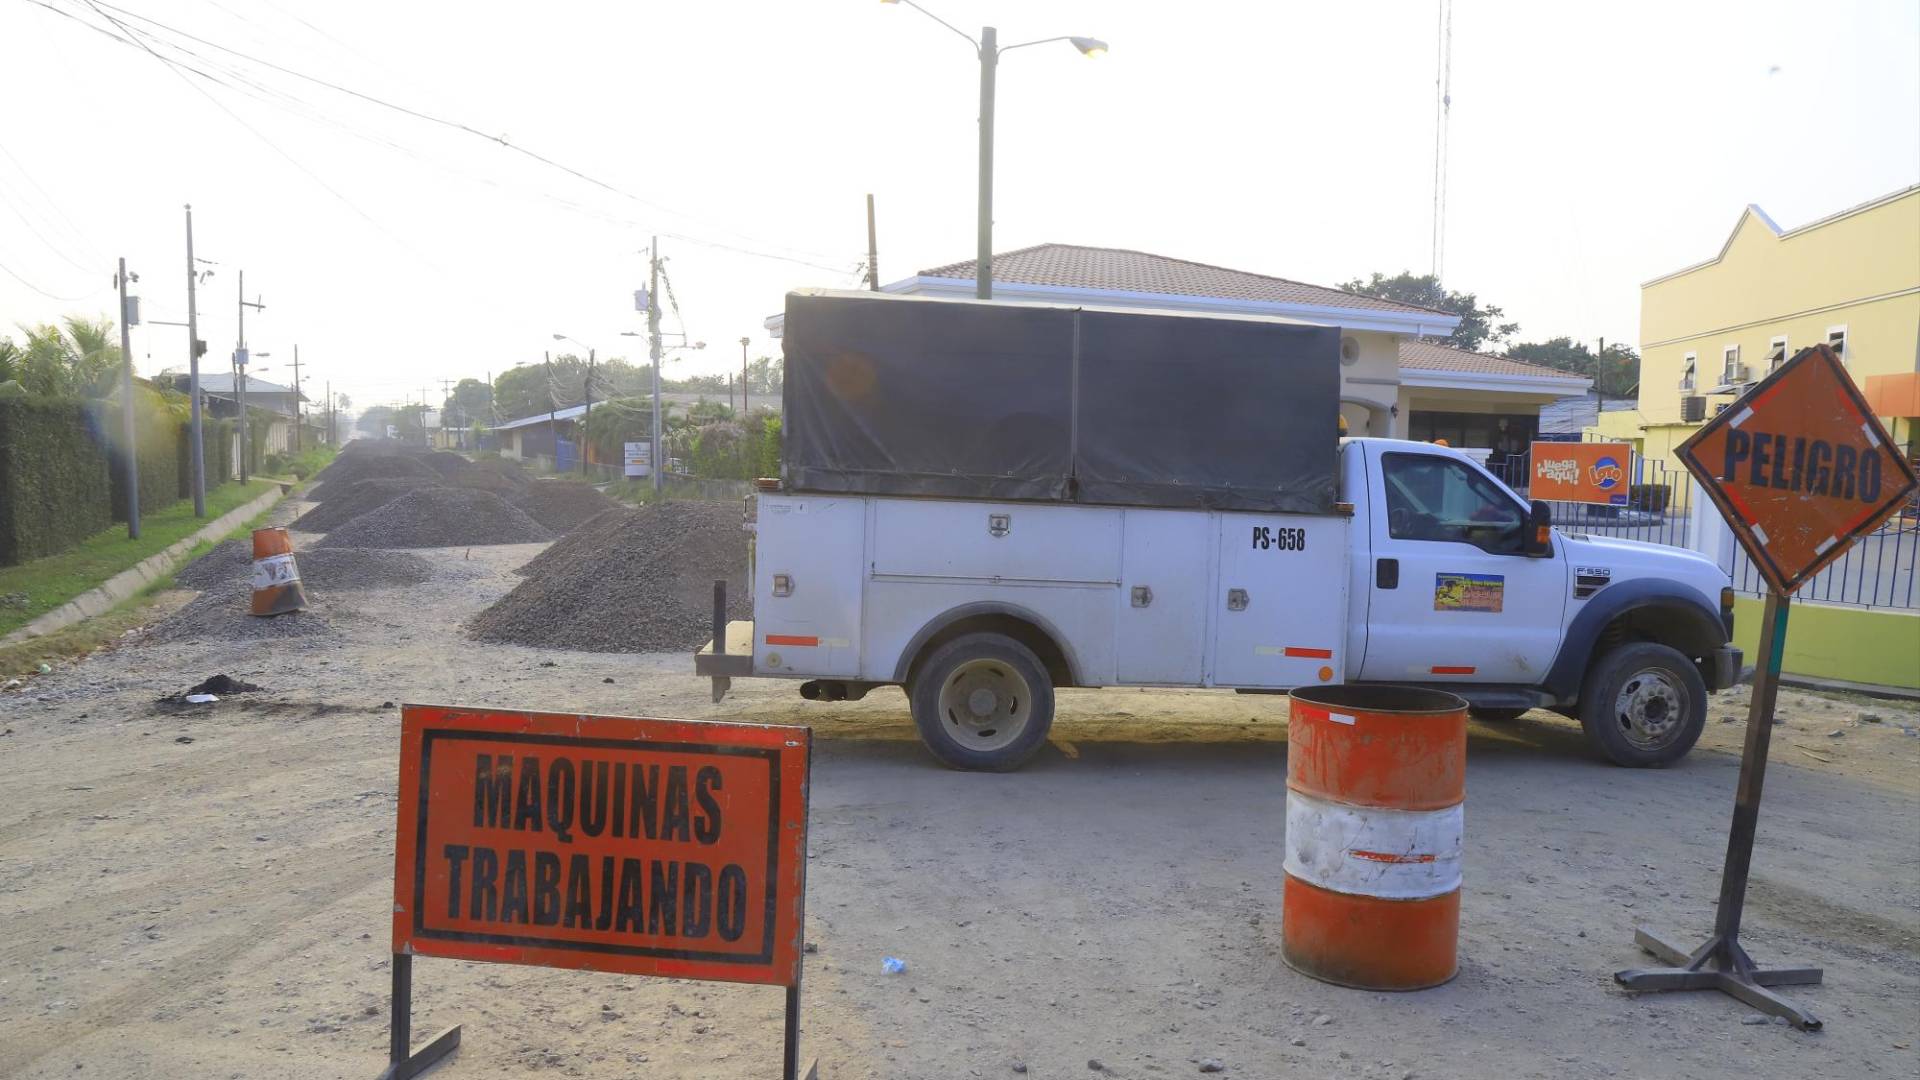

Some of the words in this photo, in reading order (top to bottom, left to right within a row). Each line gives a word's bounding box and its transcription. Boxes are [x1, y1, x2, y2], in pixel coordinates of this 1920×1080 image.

[1725, 428, 1881, 503] PELIGRO
[1253, 526, 1305, 551] PS-658
[475, 754, 723, 844] MAQUINAS
[444, 845, 747, 942] TRABAJANDO
